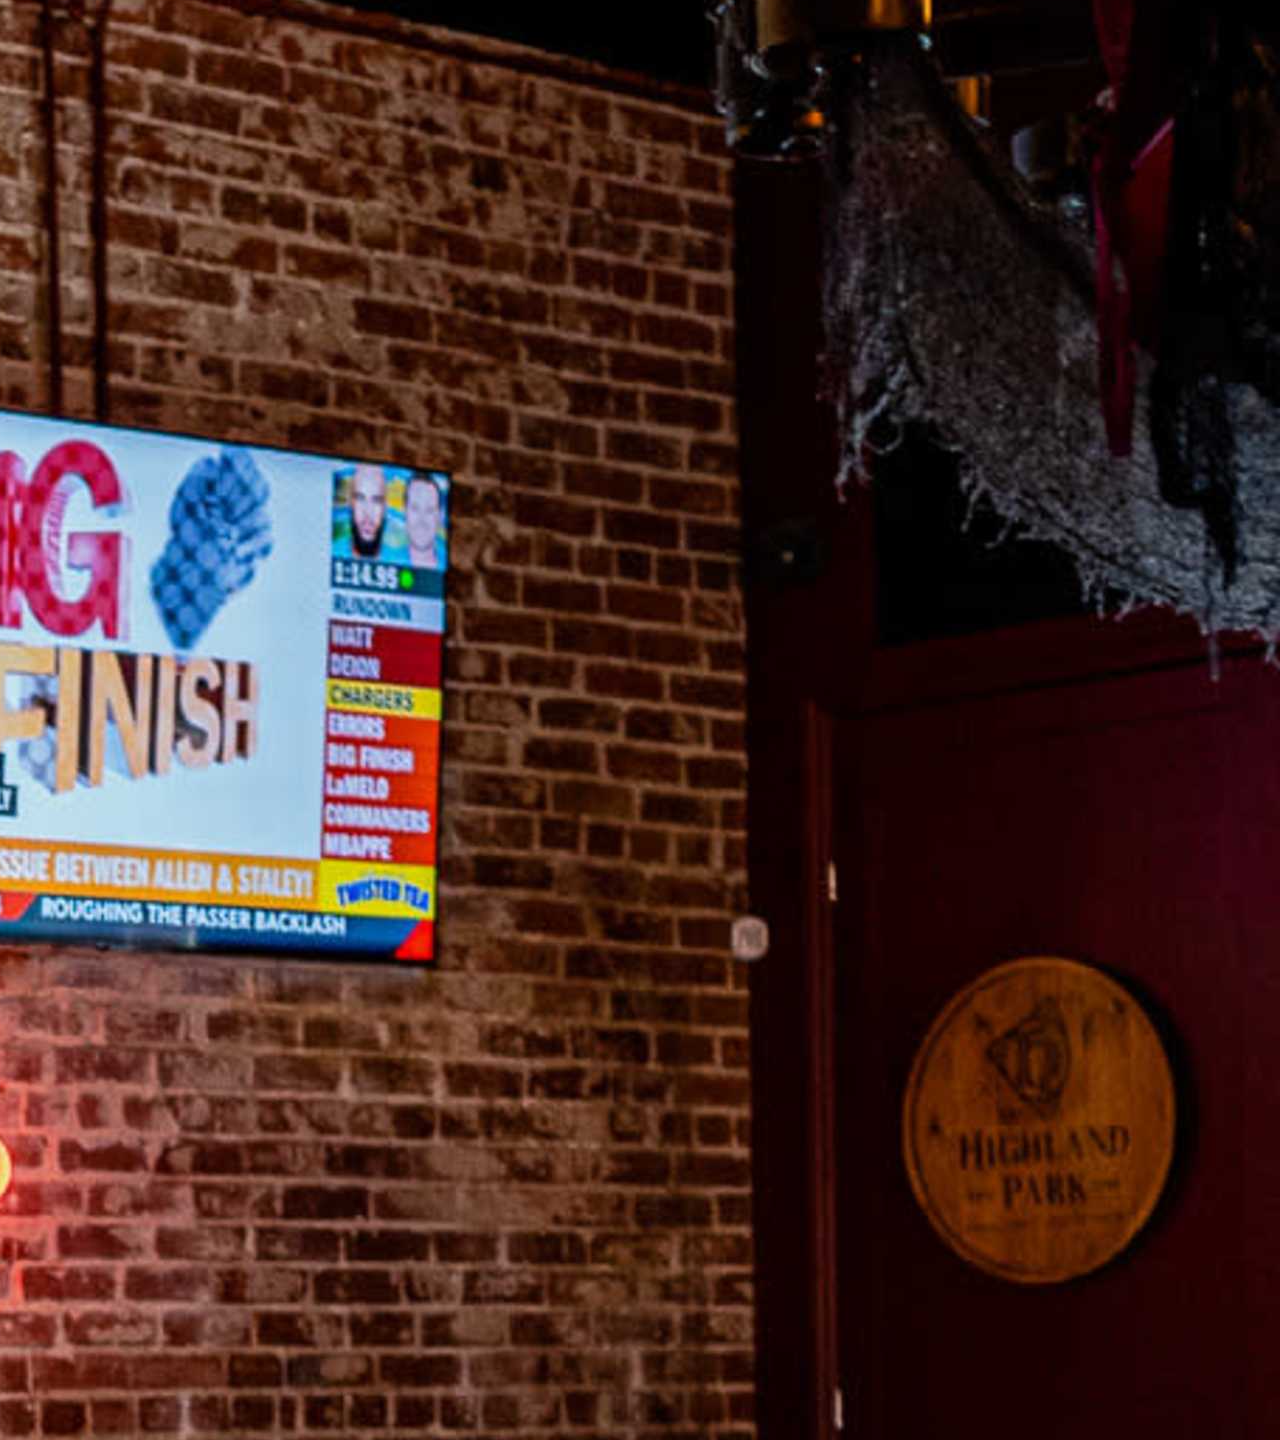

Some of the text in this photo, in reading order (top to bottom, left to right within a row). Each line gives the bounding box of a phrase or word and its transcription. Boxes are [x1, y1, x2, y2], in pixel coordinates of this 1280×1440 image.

[333, 595, 411, 620] RUNDOWN
[331, 626, 374, 649] WATT
[330, 654, 380, 679] DEION
[331, 686, 413, 711] CHARGERS
[360, 746, 414, 773] FINISH
[326, 803, 429, 833] COMMANDERS
[55, 853, 149, 888] BETWEEN
[154, 859, 212, 891] ALLEN
[216, 864, 233, 893] &
[337, 878, 429, 912] TWISTED TEA
[42, 900, 346, 935] ROUGHING THE PASSER BACKLASH
[959, 1126, 1131, 1171] HIGHLAND
[1003, 1172, 1086, 1210] PARK
